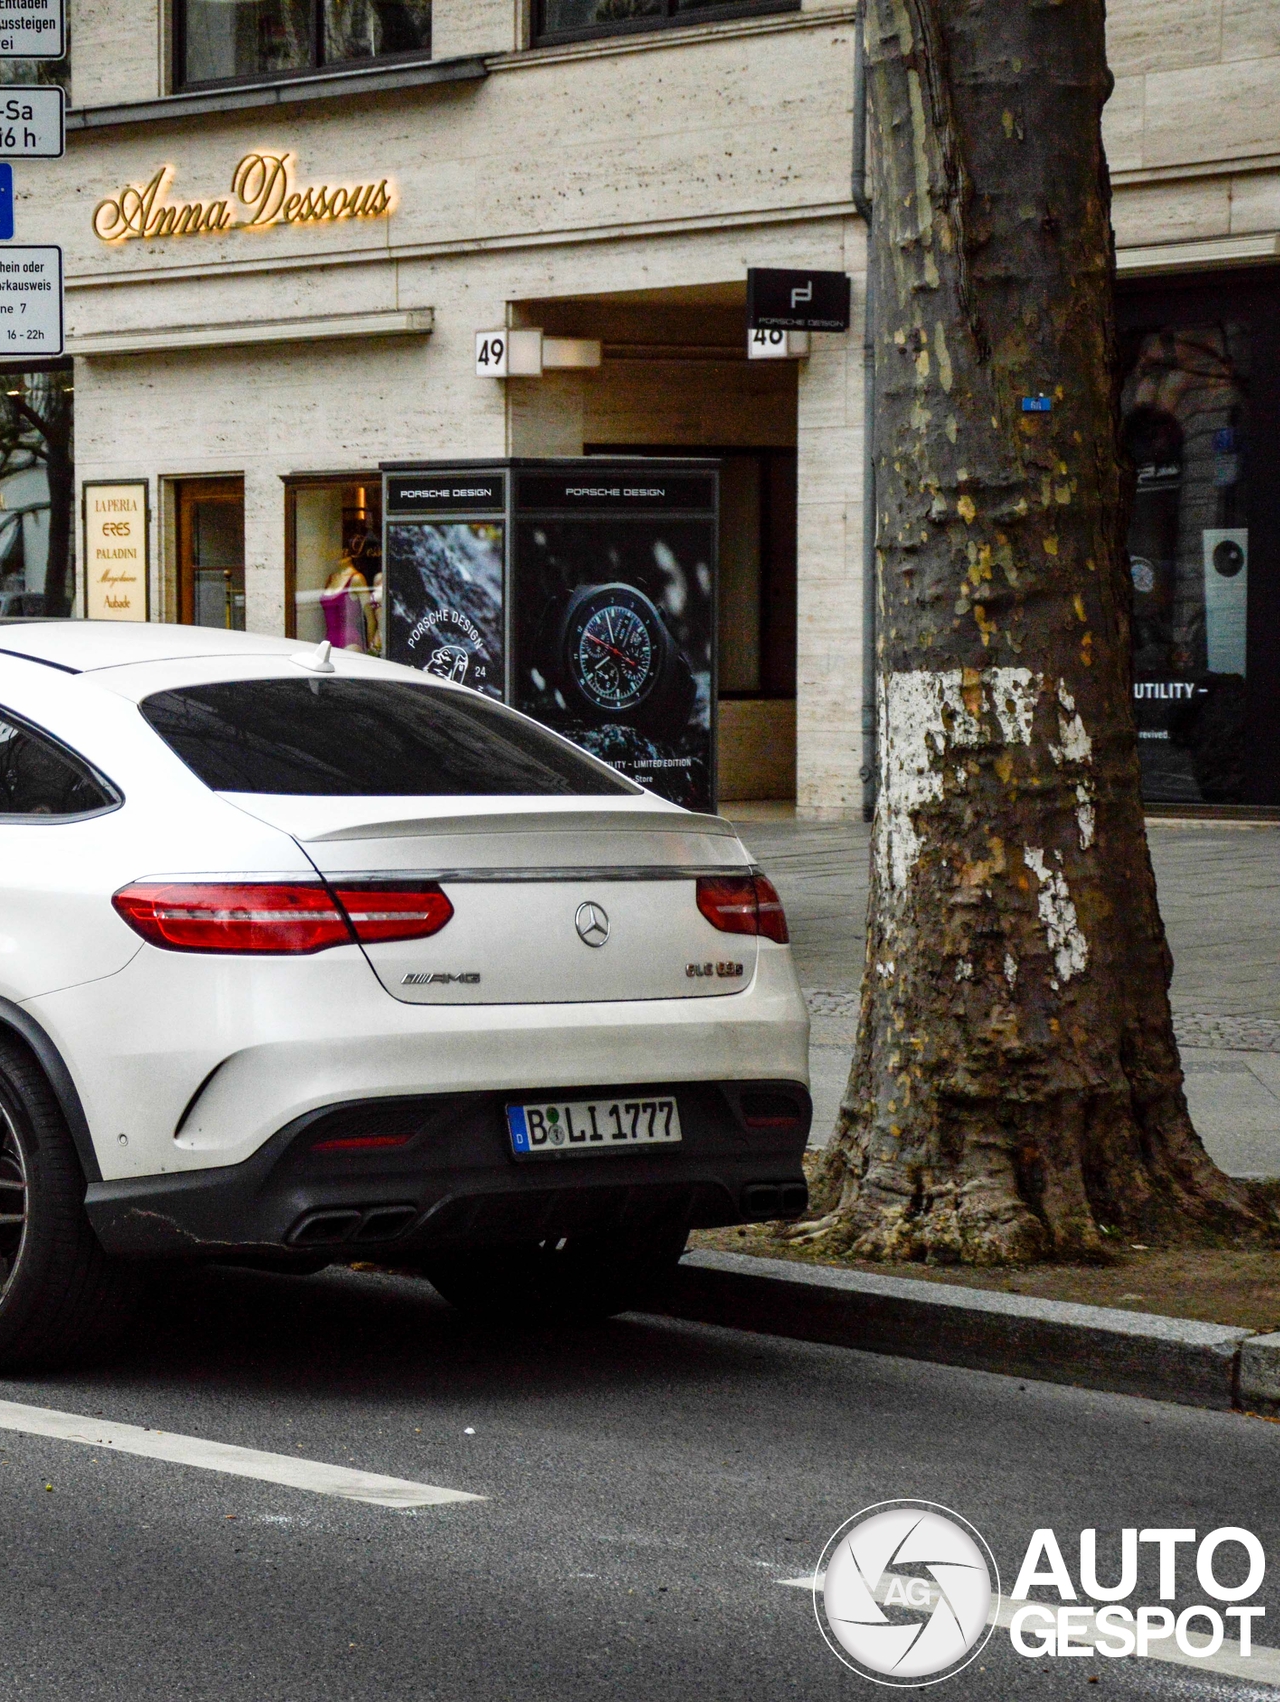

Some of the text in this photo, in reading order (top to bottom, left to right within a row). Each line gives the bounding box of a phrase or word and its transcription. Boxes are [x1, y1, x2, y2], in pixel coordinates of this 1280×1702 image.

[24, 127, 37, 147] h
[91, 153, 391, 241] Anna Dessous
[23, 261, 45, 273] oder
[20, 303, 27, 315] 7
[759, 317, 845, 328] PORSCHE DESIGN
[477, 338, 504, 366] 49
[400, 488, 492, 498] PORSCHE DESIGN
[566, 488, 666, 497] PORSCHE DESIGN
[102, 522, 131, 537] ERES
[96, 548, 138, 560] PALADINI
[407, 609, 483, 650] PORSCHE DESIGN
[475, 666, 487, 678] 24
[1134, 683, 1195, 699] UTILITY
[633, 759, 662, 769] LIMITED
[663, 758, 692, 768] EDITION
[428, 972, 481, 985] AMG
[527, 1101, 674, 1146] B LI 1777
